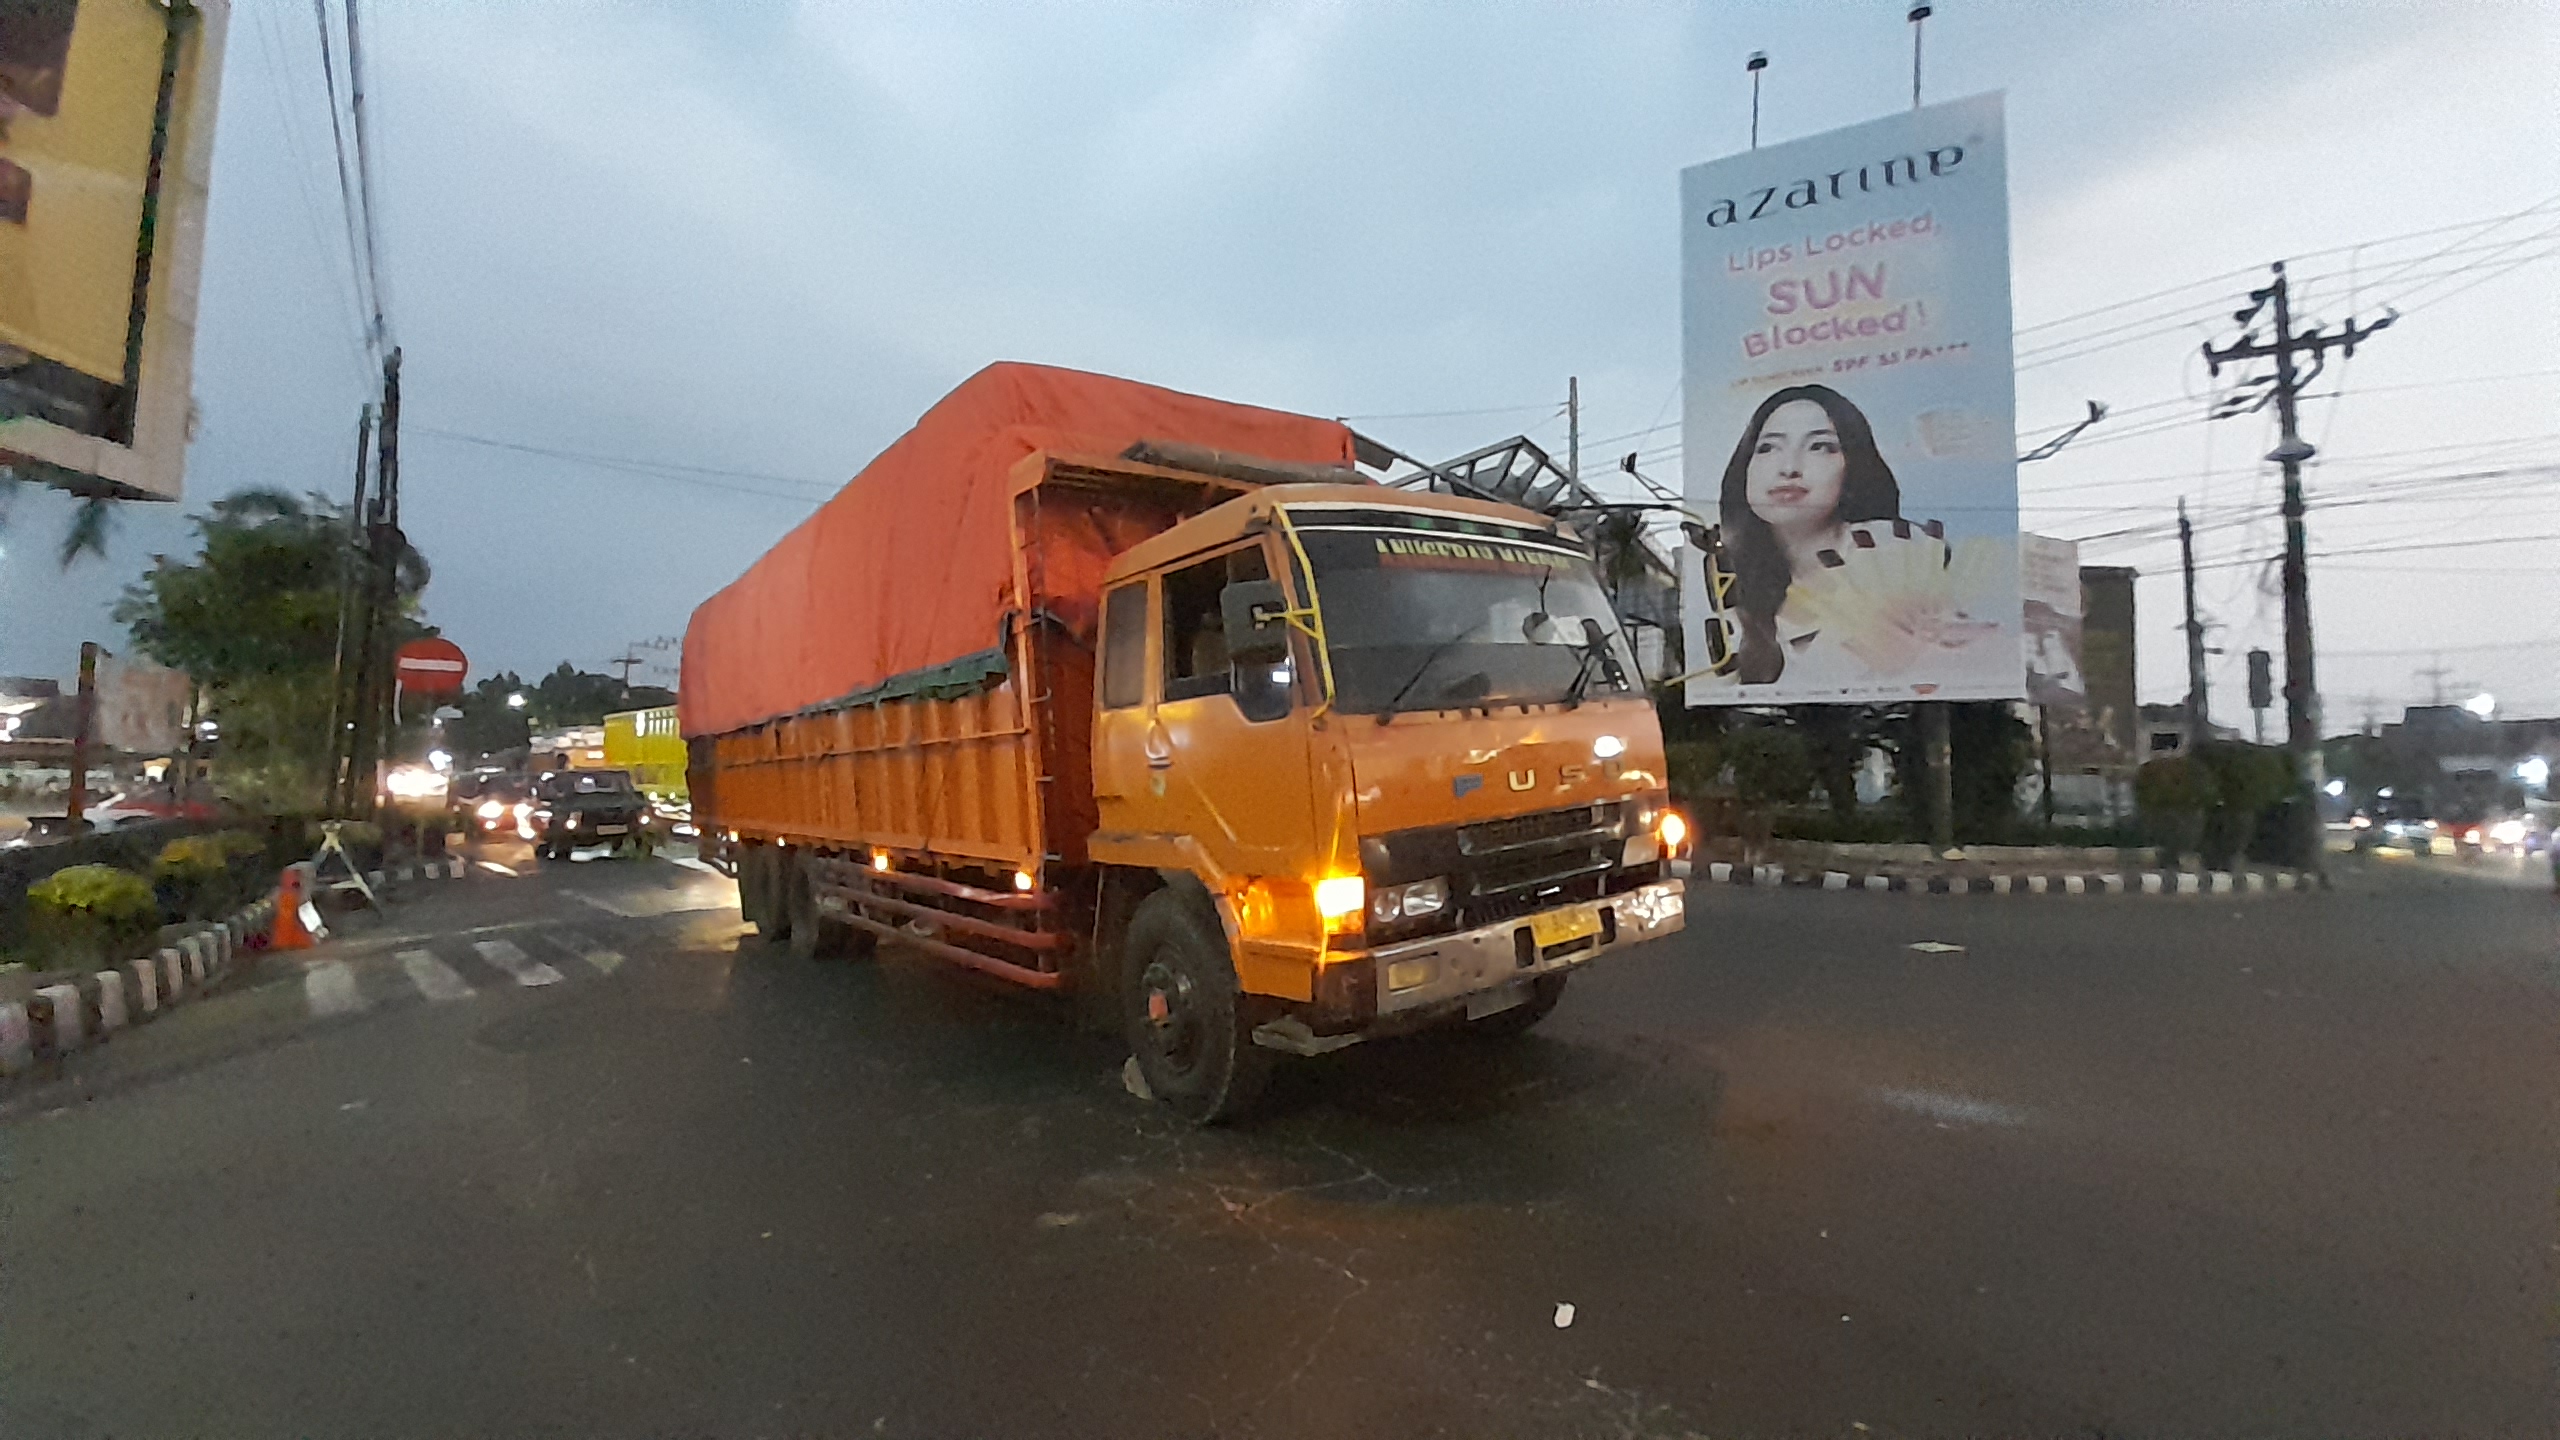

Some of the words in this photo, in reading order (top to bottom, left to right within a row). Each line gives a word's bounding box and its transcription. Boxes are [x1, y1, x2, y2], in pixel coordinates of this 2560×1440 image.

[1706, 145, 1964, 228] azarine
[1729, 244, 1793, 272] Lips
[1766, 262, 1885, 315] SUN
[1833, 355, 1869, 373] SPF
